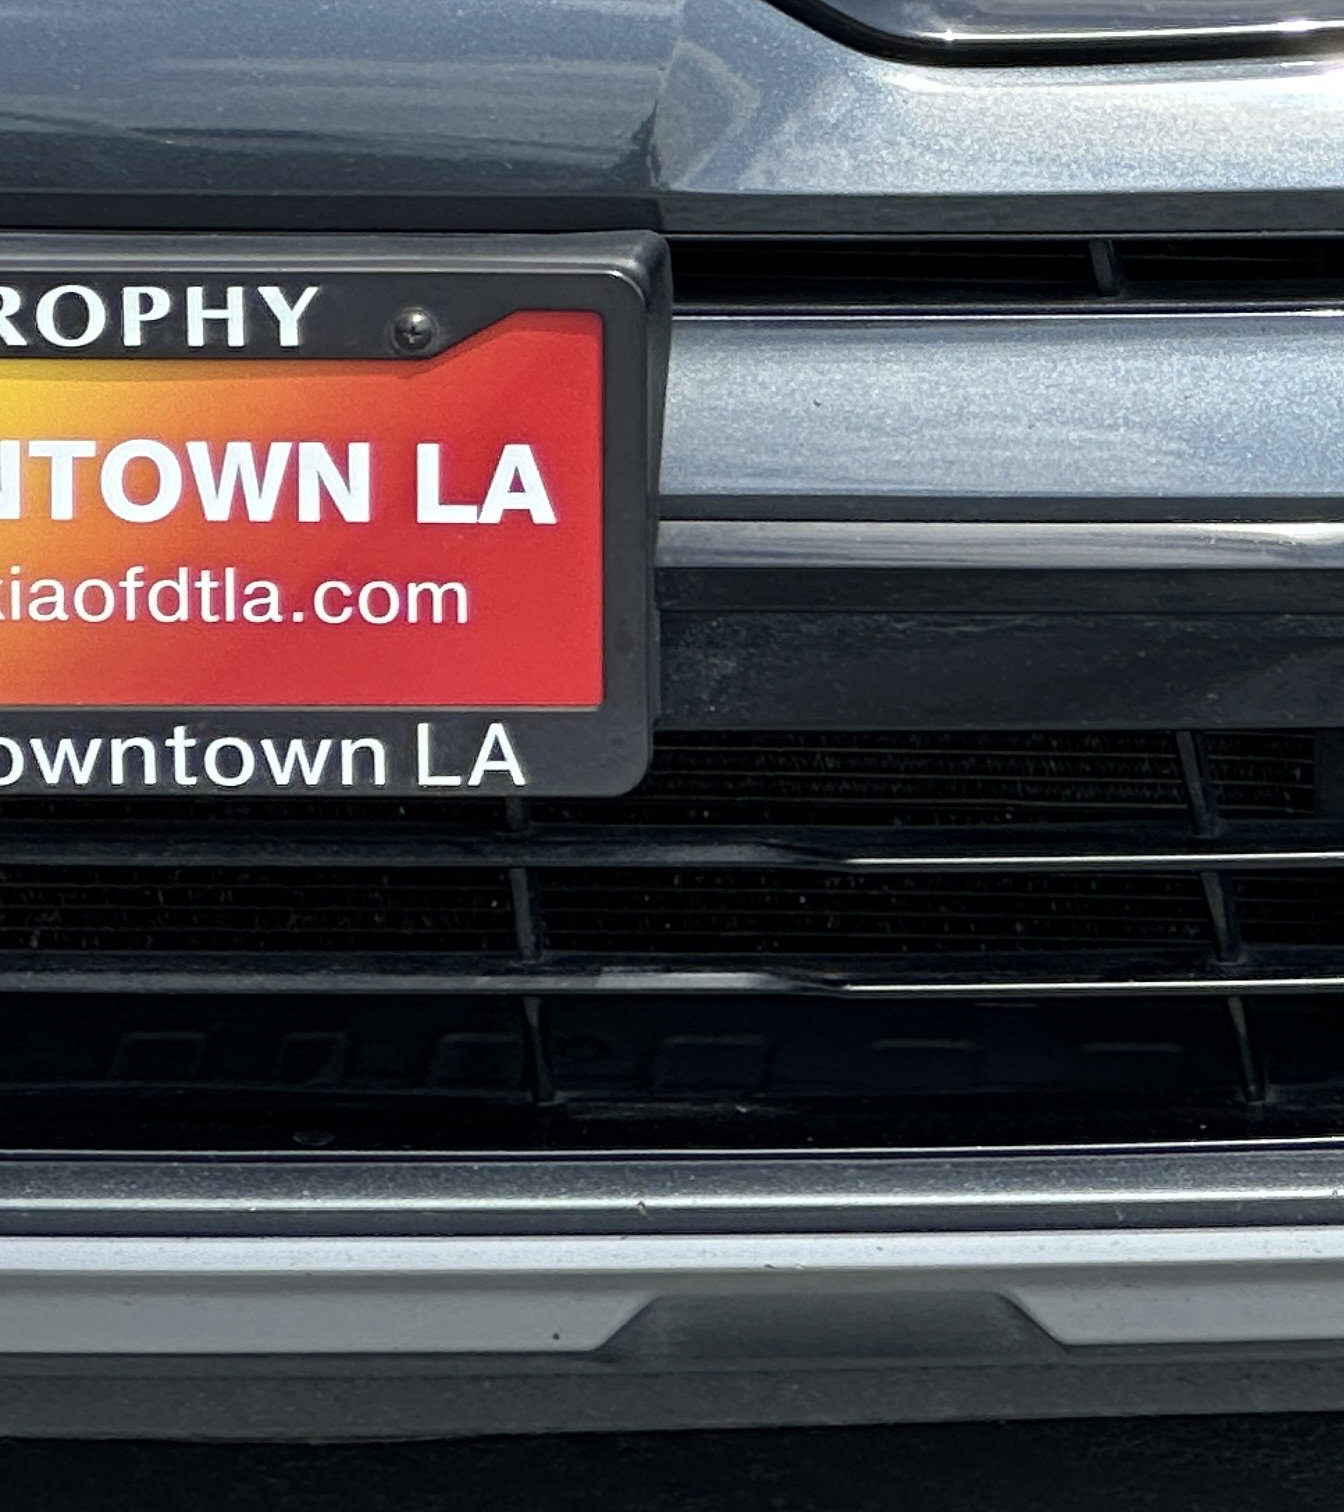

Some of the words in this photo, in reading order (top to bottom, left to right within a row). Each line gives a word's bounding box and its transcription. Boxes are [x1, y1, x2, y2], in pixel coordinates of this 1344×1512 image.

[0, 439, 371, 524] TOWN
[416, 443, 557, 525] LA
[0, 565, 469, 625] iaofdtla.com
[417, 722, 527, 787] LA
